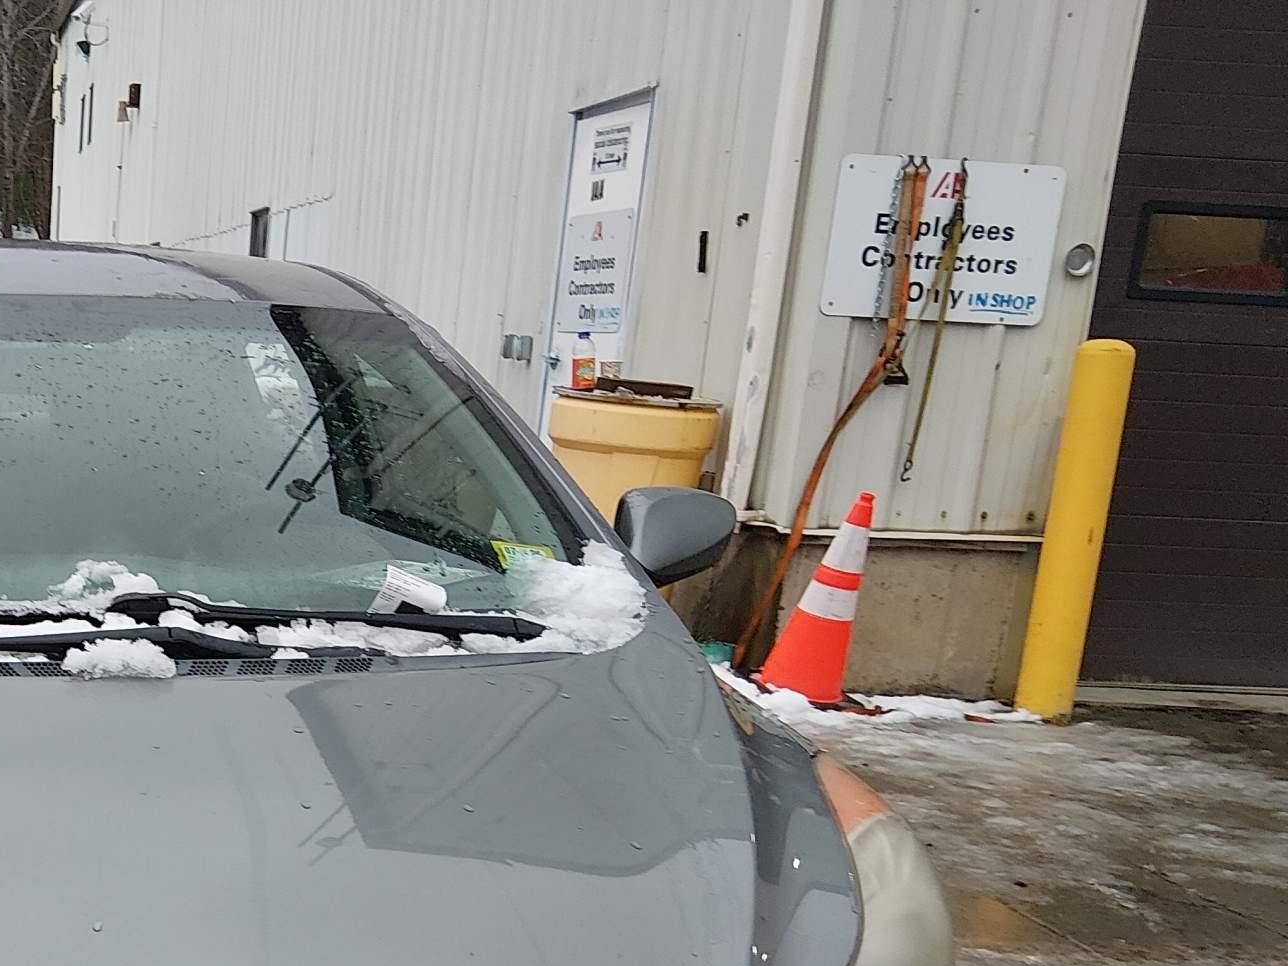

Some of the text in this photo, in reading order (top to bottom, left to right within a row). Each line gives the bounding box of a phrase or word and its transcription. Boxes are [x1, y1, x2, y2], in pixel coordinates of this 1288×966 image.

[573, 254, 616, 274] Employees
[861, 245, 1018, 275] Cotractors
[568, 279, 616, 296] Contractors
[906, 281, 964, 309] Ony
[578, 303, 597, 323] Only
